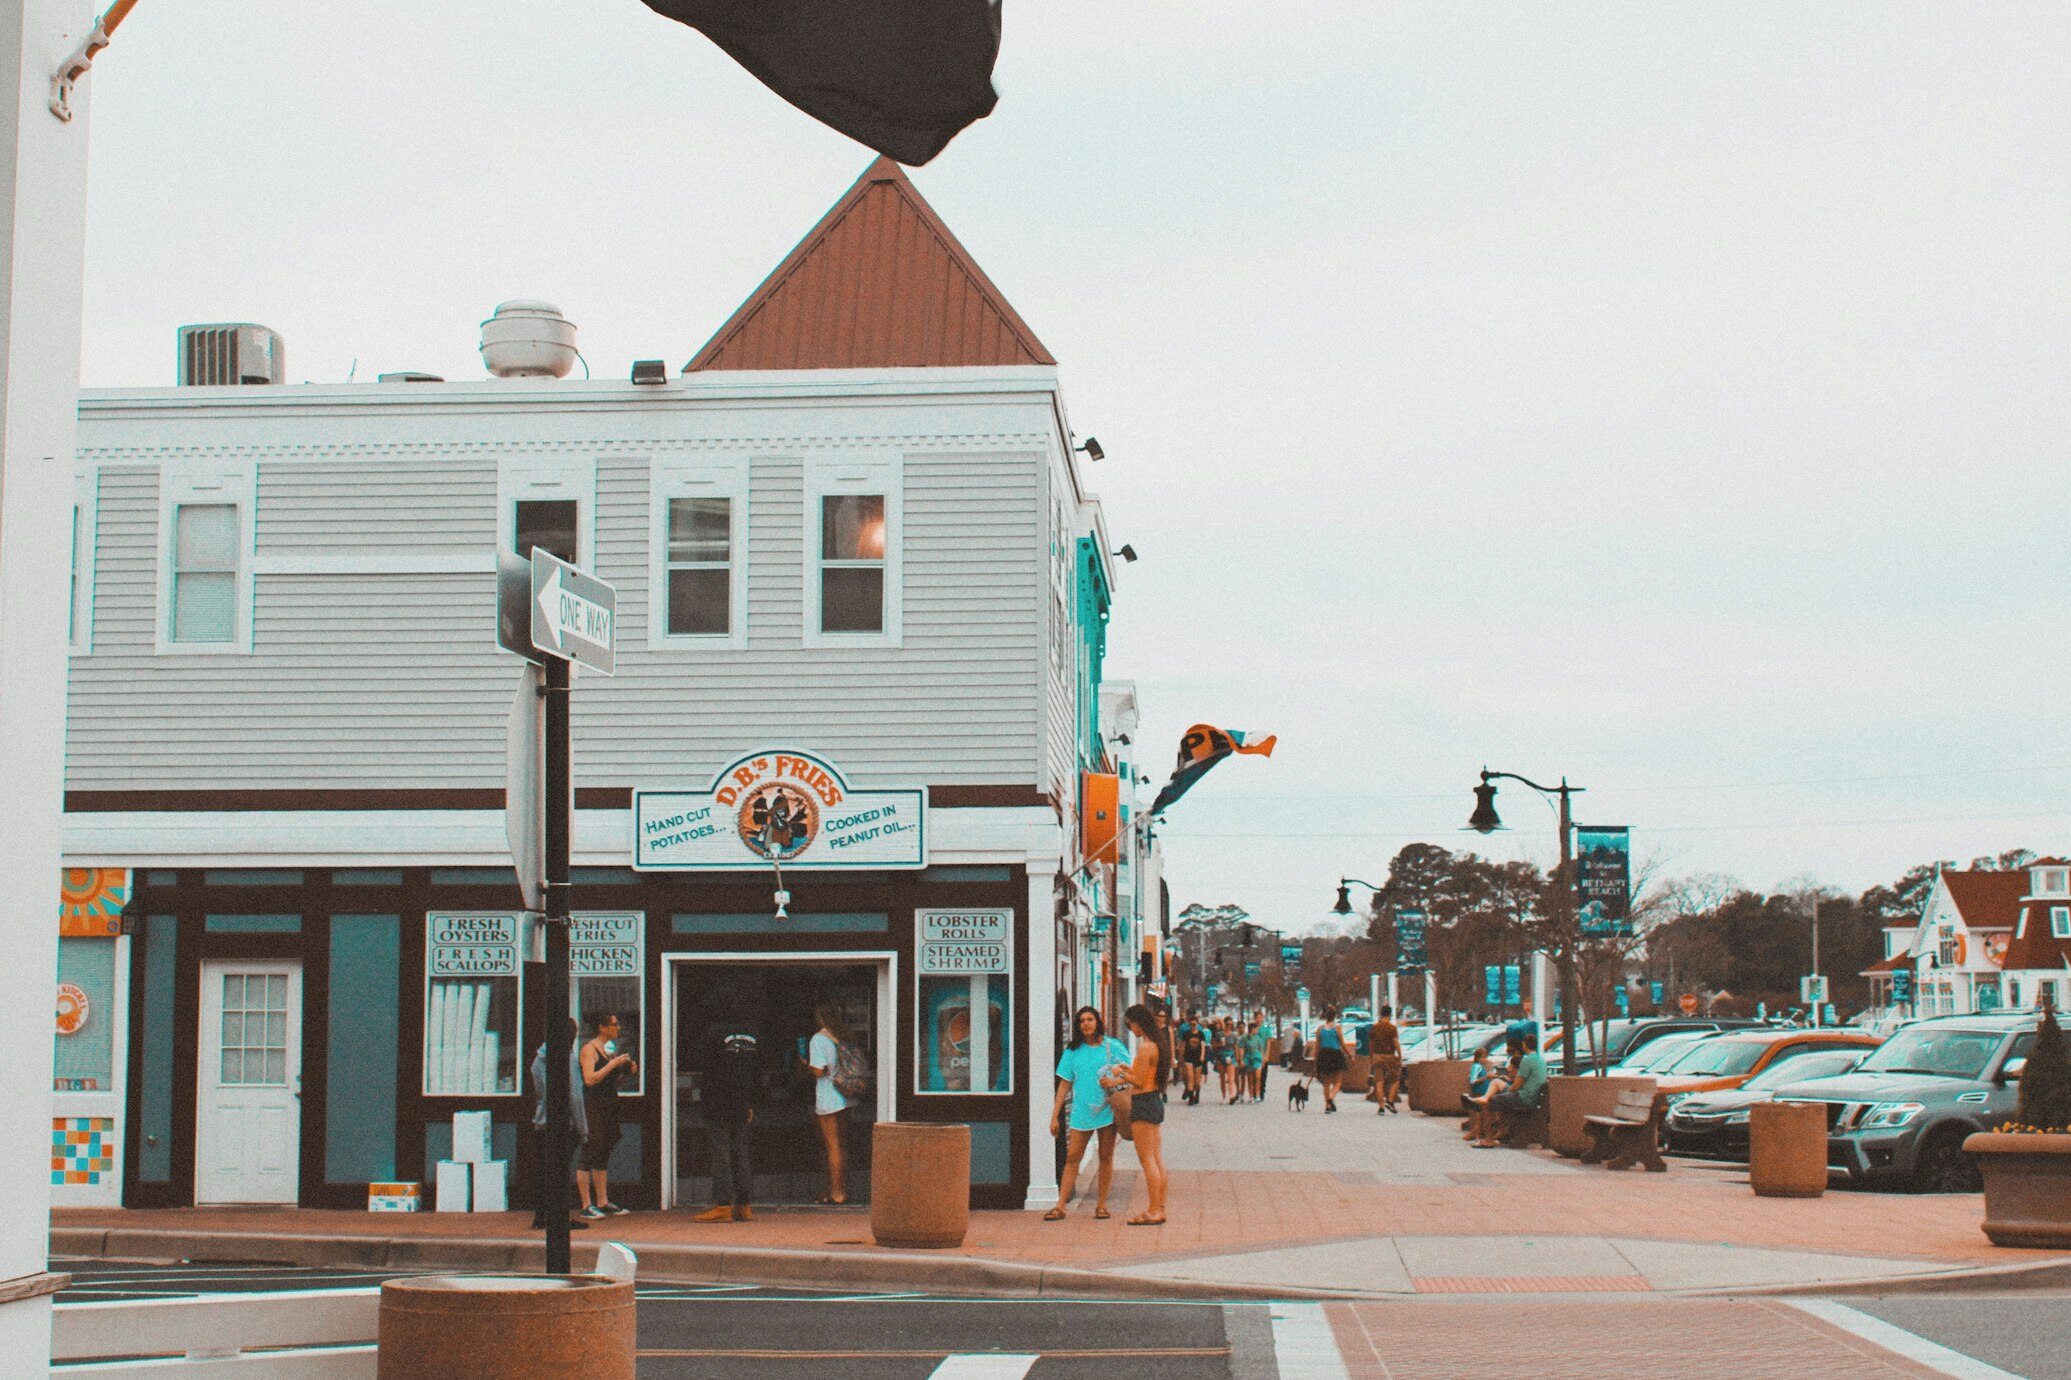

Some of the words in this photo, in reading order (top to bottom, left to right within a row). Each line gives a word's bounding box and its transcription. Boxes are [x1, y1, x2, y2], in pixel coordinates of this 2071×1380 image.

[560, 593, 582, 631] ONE
[586, 606, 609, 642] WAY
[775, 756, 843, 807] FRIES
[645, 815, 685, 835] HAND
[686, 807, 711, 823] CUT
[825, 809, 881, 832] COOKED
[882, 804, 897, 817] IN
[829, 826, 881, 850] PEANUT
[448, 918, 501, 930] FRESH
[603, 919, 633, 930] CUT
[929, 915, 999, 928] LOBSTER
[440, 930, 510, 942] OYSTERS
[576, 930, 616, 941] FRIES
[942, 928, 986, 939] ROLLS
[438, 948, 510, 960] FRESH
[571, 948, 633, 960] HICKEN
[928, 946, 1000, 957] STEAMED
[438, 959, 511, 971] SCALLOPS
[570, 960, 634, 971] ENDERS
[928, 957, 1001, 969] SHRIMP
